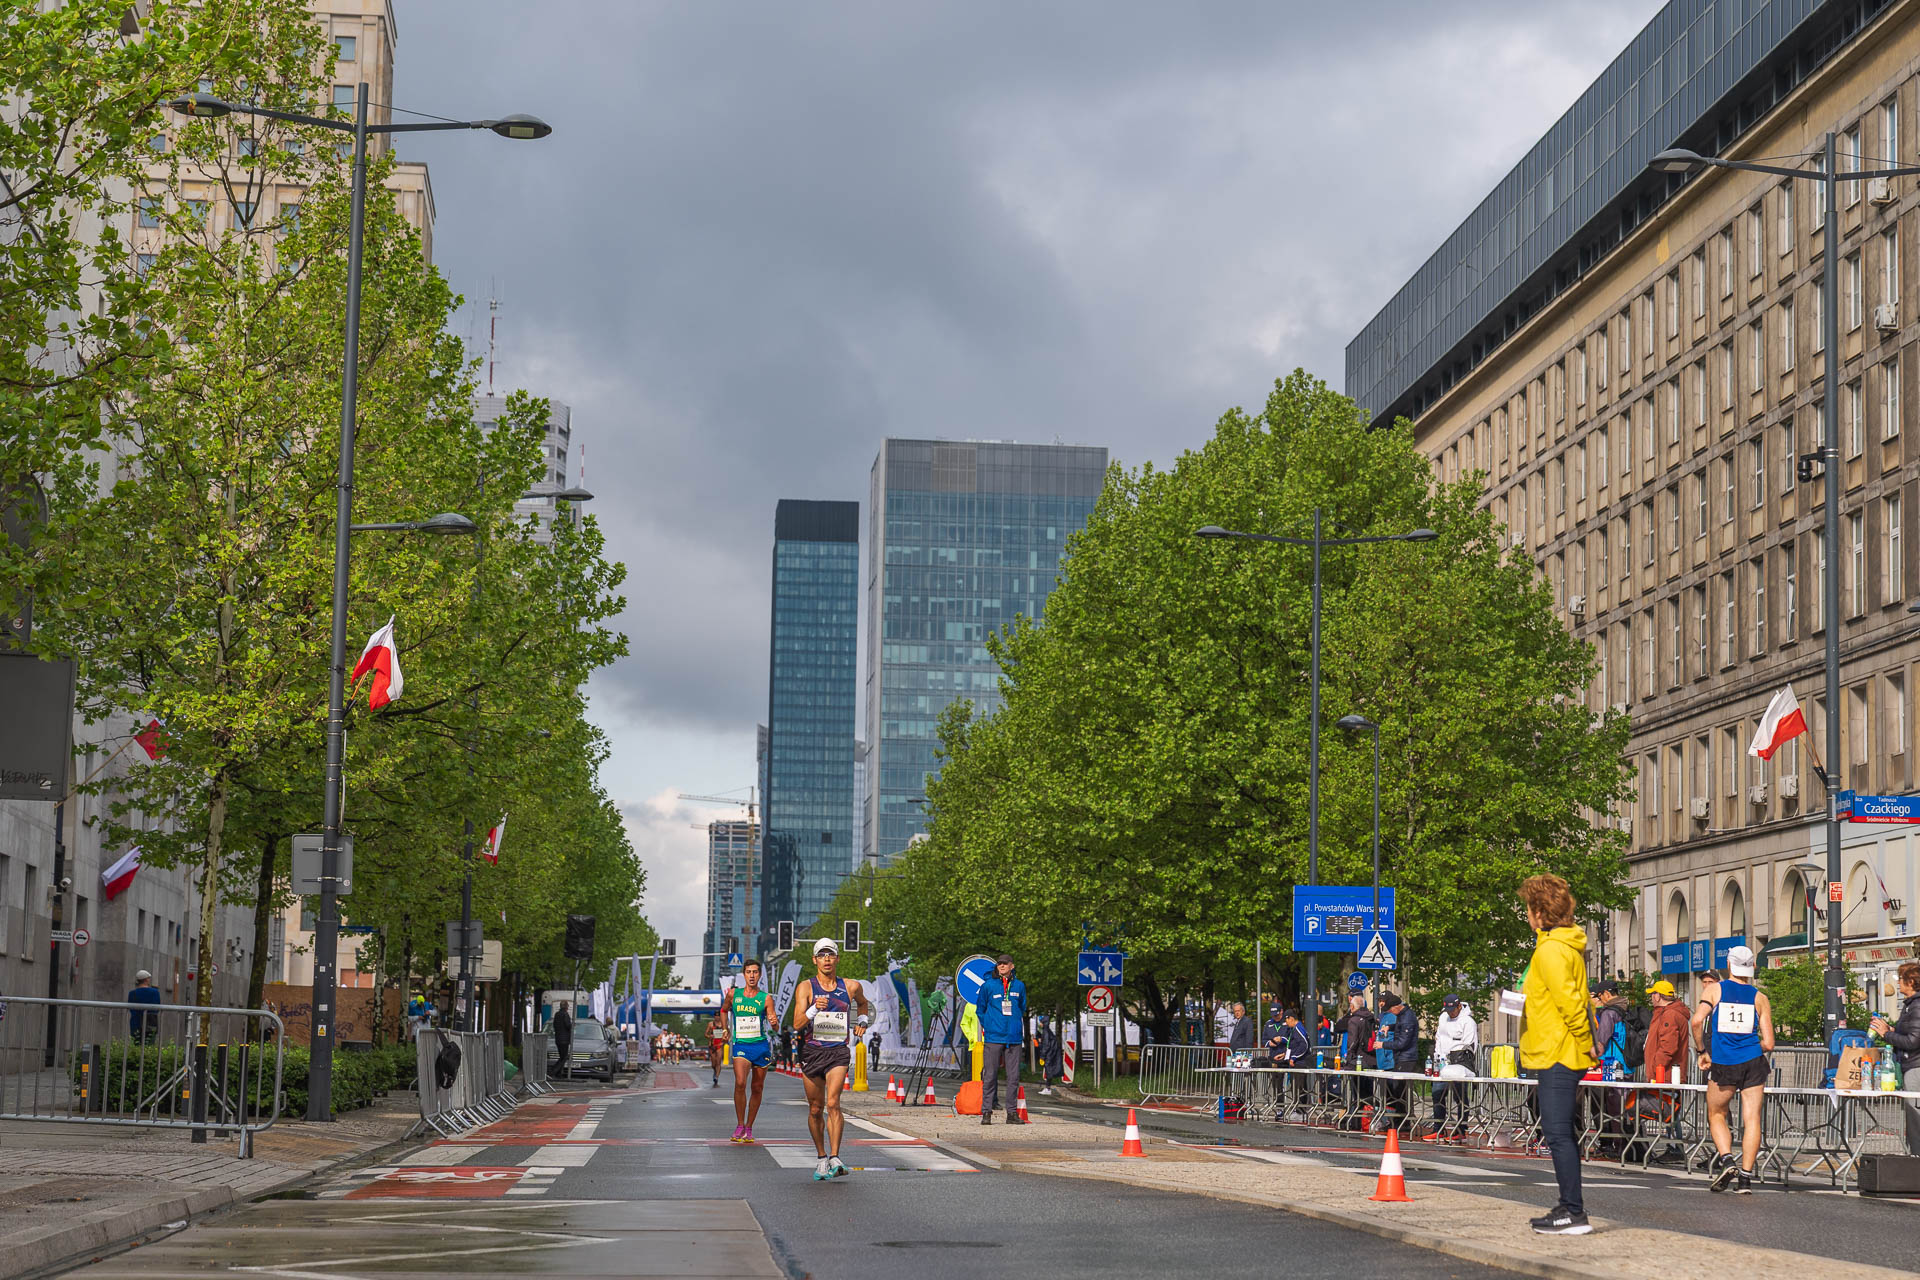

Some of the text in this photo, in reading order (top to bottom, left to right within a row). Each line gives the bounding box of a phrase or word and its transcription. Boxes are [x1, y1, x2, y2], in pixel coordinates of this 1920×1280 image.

[1864, 803, 1910, 816] Czackiego
[1304, 904, 1313, 913] pl.
[1314, 903, 1355, 913] Powstańców
[1308, 921, 1318, 933] P
[736, 1004, 757, 1015] BRASIL
[1729, 1012, 1744, 1022] 11
